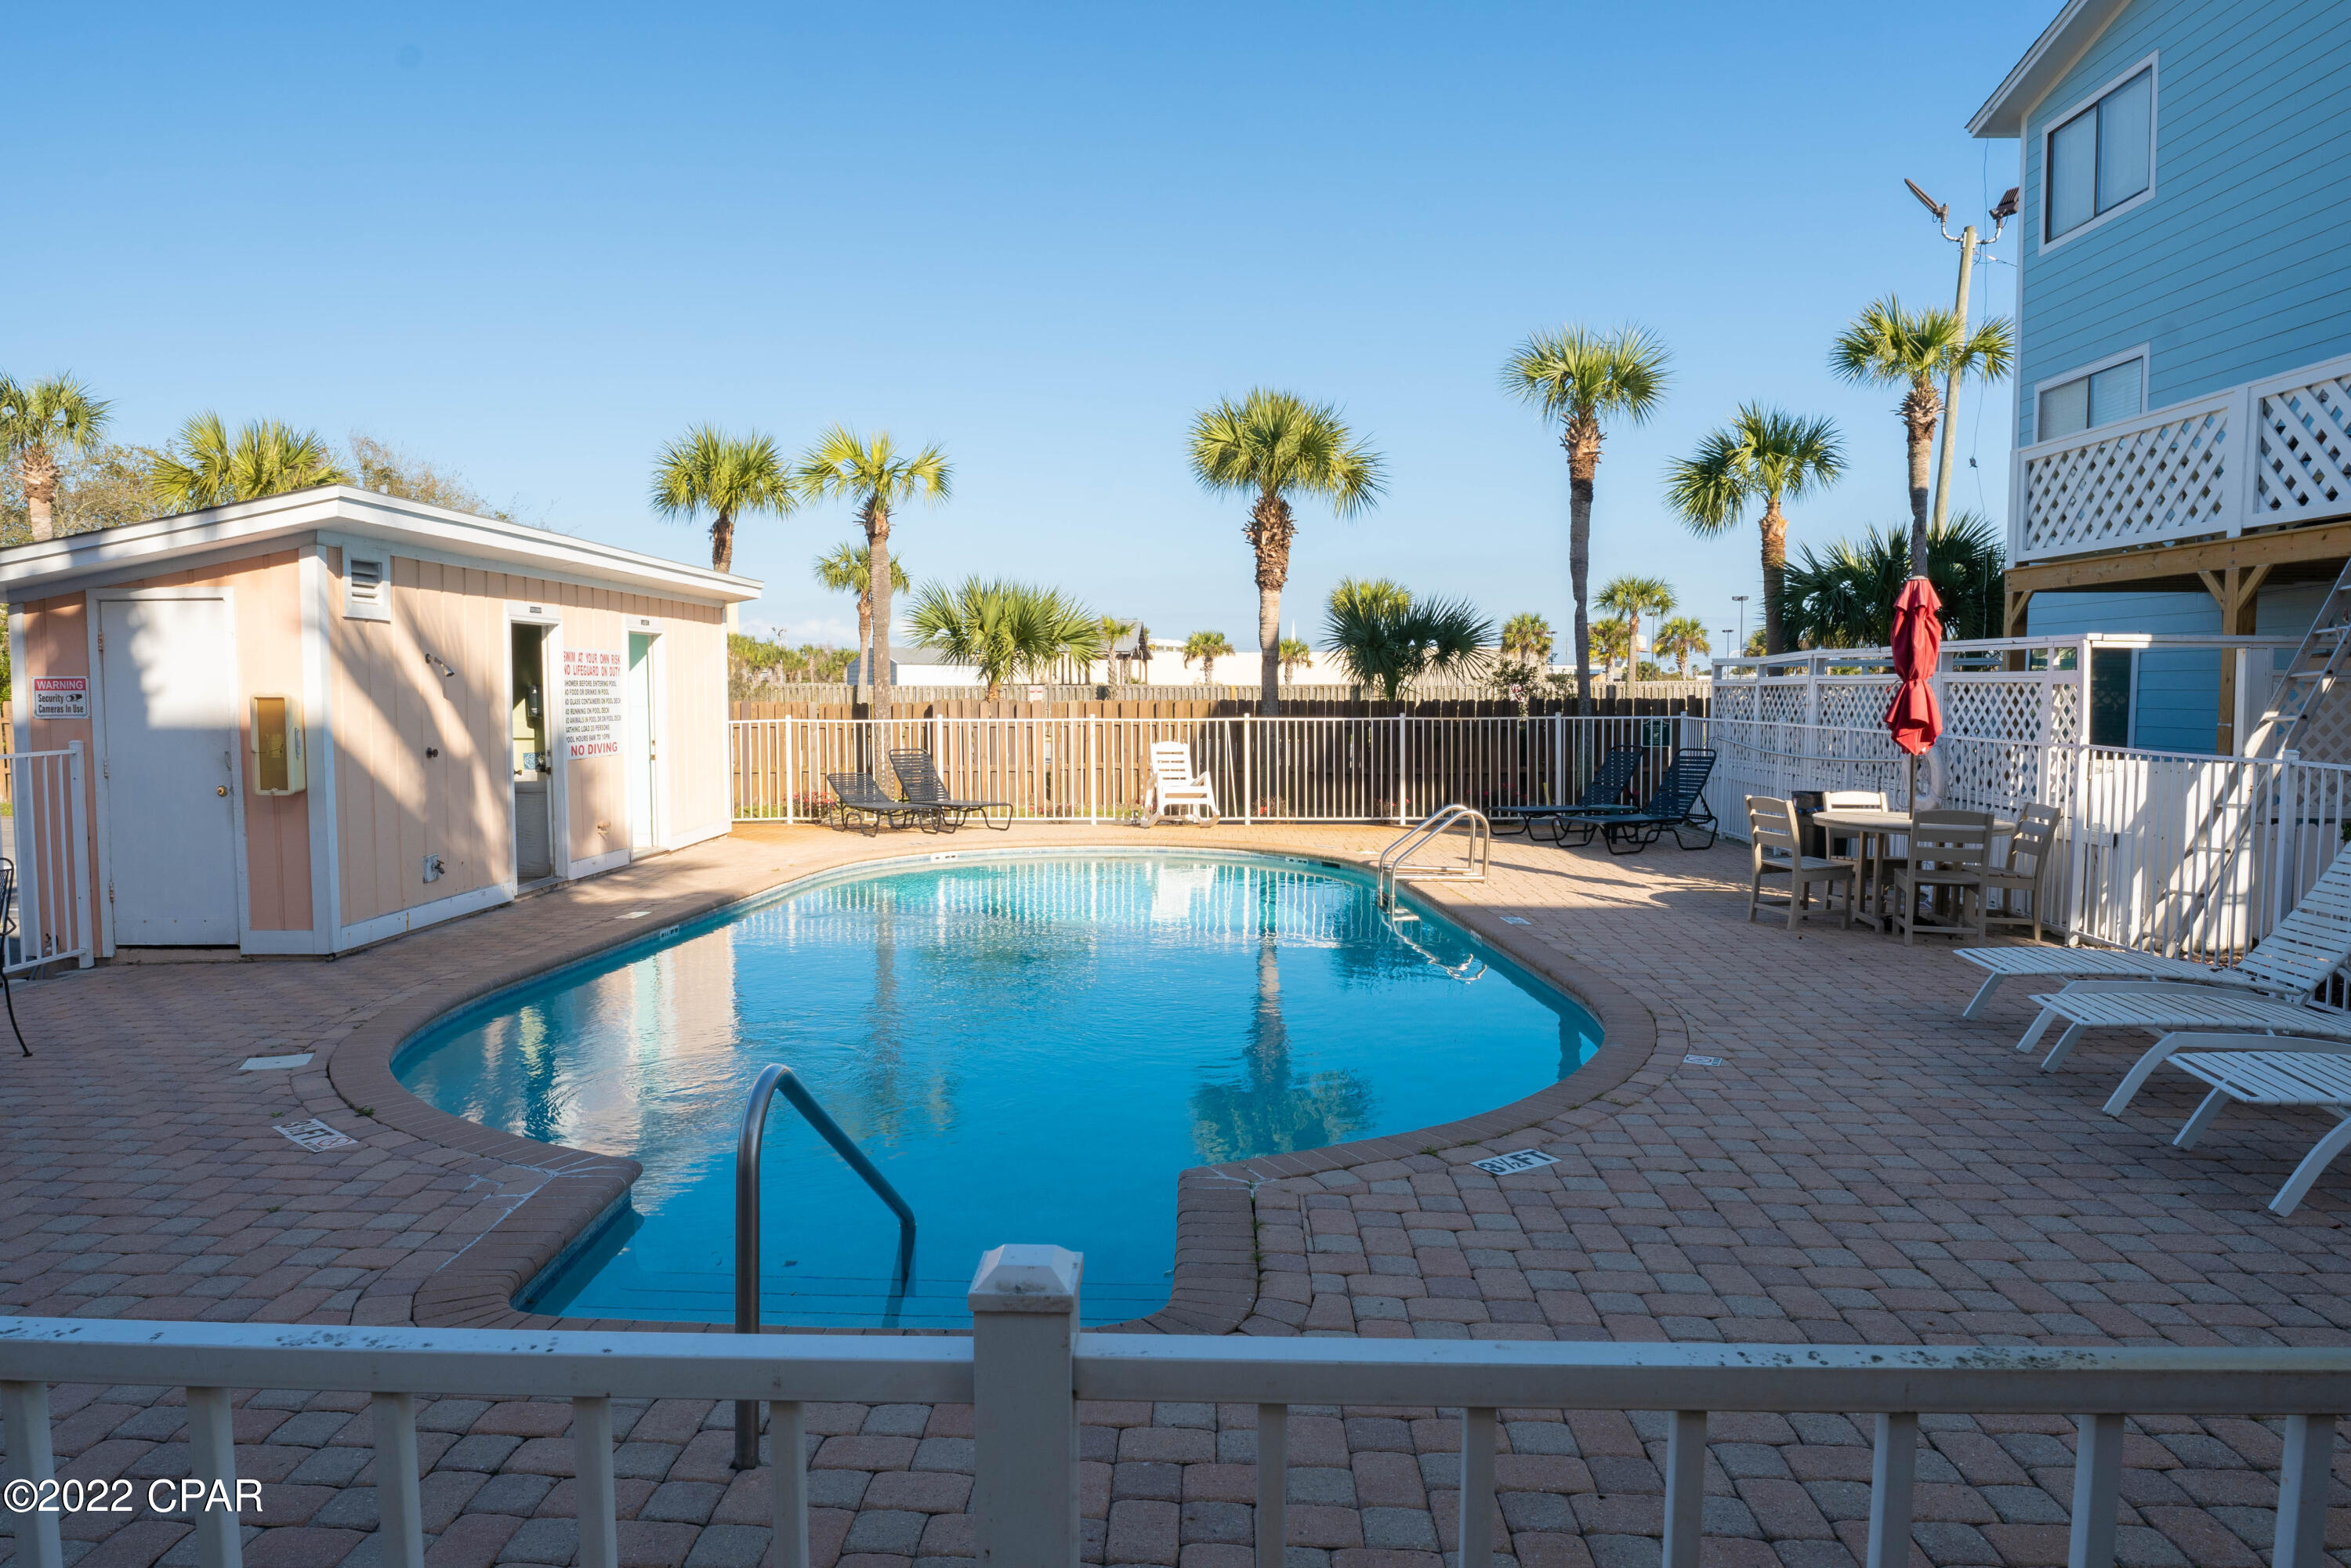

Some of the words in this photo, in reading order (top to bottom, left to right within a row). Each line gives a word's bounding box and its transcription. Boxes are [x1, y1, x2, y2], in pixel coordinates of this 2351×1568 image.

[564, 651, 576, 663] SWIM
[578, 652, 583, 663] AT
[586, 653, 598, 664] YOUR
[600, 653, 609, 664] OWN
[611, 654, 620, 665] RISK
[573, 665, 598, 676] LIFEGUARD
[601, 666, 607, 676] ON
[610, 666, 620, 677] DUTY
[37, 681, 83, 689] WARNING
[38, 694, 64, 704] Security
[38, 704, 64, 713] Cameras
[66, 704, 71, 712] In
[73, 704, 83, 713] Use
[571, 745, 585, 756] NO
[588, 742, 617, 755] DIVING
